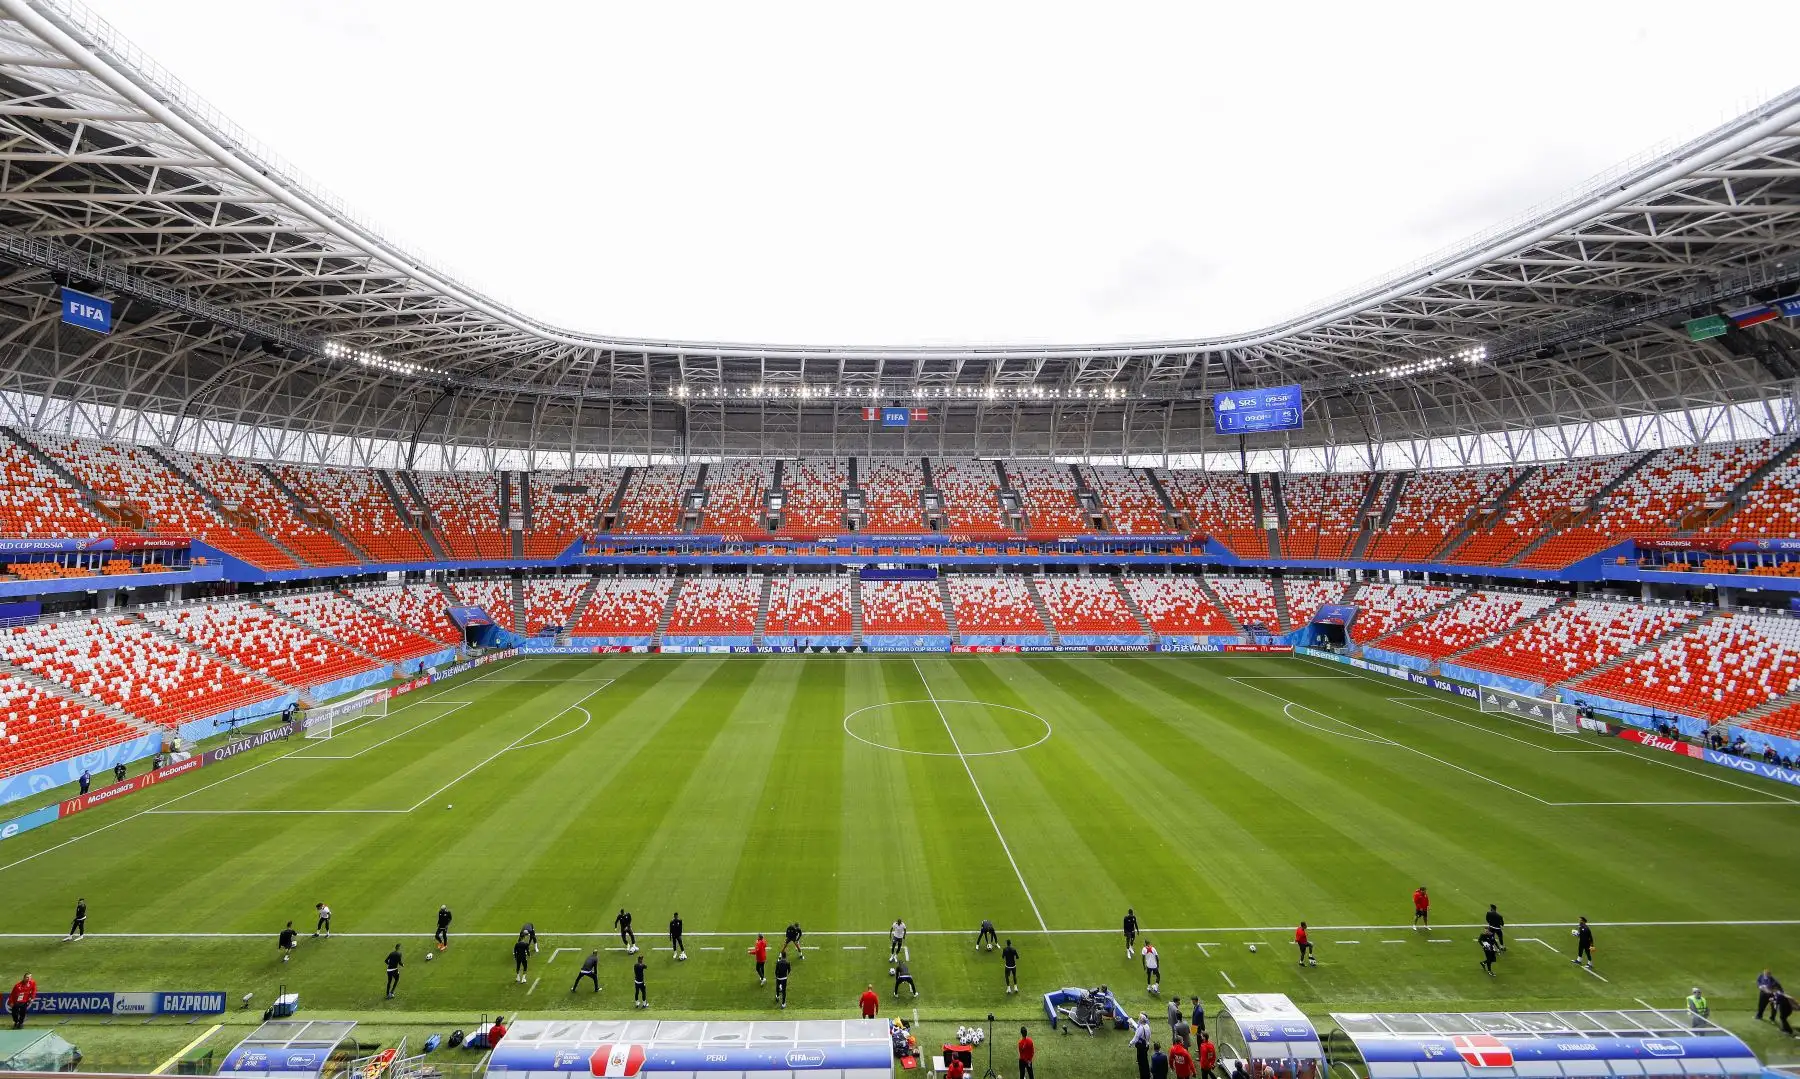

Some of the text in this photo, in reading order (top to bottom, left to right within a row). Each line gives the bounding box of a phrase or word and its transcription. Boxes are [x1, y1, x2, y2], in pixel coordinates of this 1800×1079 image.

[70, 301, 104, 322] FIFA
[1238, 399, 1257, 407] SRS
[601, 646, 622, 654] Bud
[1306, 648, 1340, 661] Hisense
[1411, 674, 1428, 685] VISA
[1434, 680, 1451, 691] VISA
[1459, 686, 1478, 698] VISA
[214, 726, 293, 761] QATAR AIRWAYS
[1638, 730, 1676, 752] Bud
[1710, 752, 1755, 771] vivo
[159, 760, 197, 778] McDonald's
[88, 782, 134, 804] McDonald's
[0, 823, 19, 838] e
[58, 997, 110, 1010] WANDA
[163, 995, 222, 1011] GAZPROM
[705, 1054, 727, 1062] PERU
